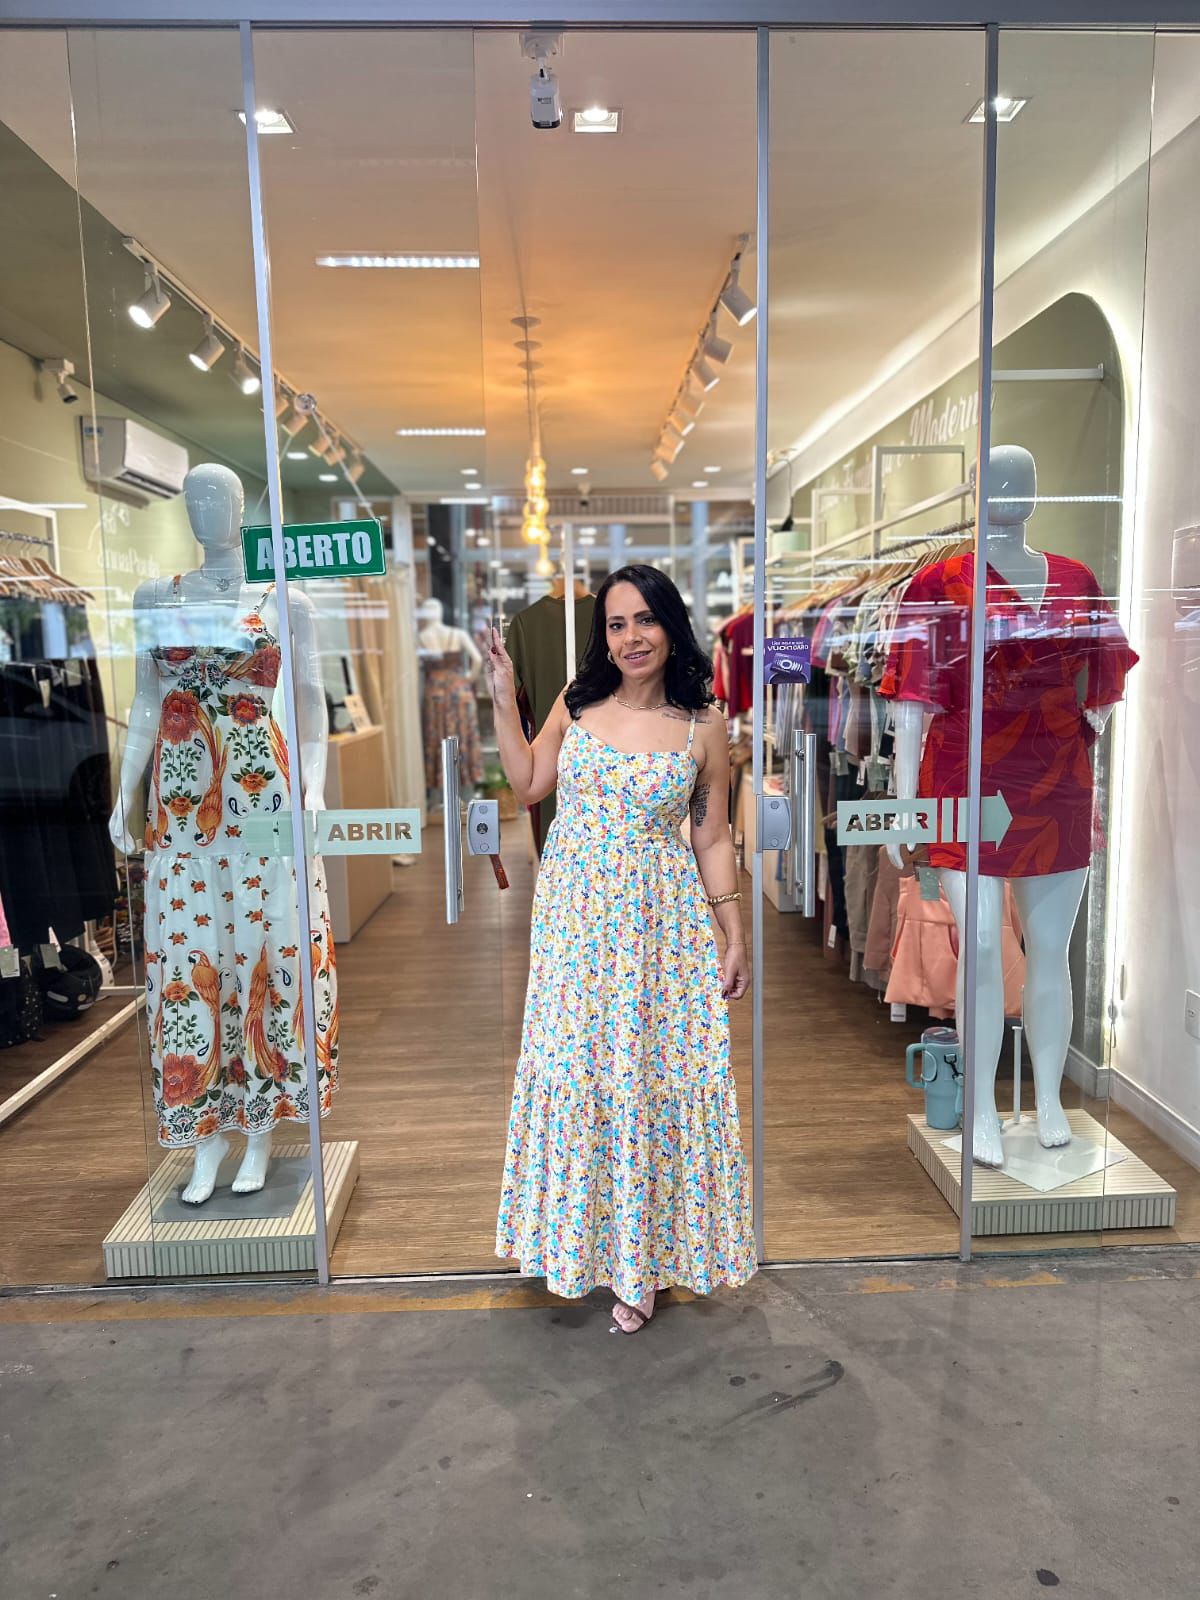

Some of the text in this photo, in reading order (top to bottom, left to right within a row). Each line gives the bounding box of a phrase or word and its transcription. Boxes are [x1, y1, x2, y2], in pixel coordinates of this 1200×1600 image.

[909, 391, 988, 449] Modern
[256, 531, 372, 571] ABERTO
[327, 822, 413, 842] ABRIR
[845, 812, 929, 832] ABRIR
